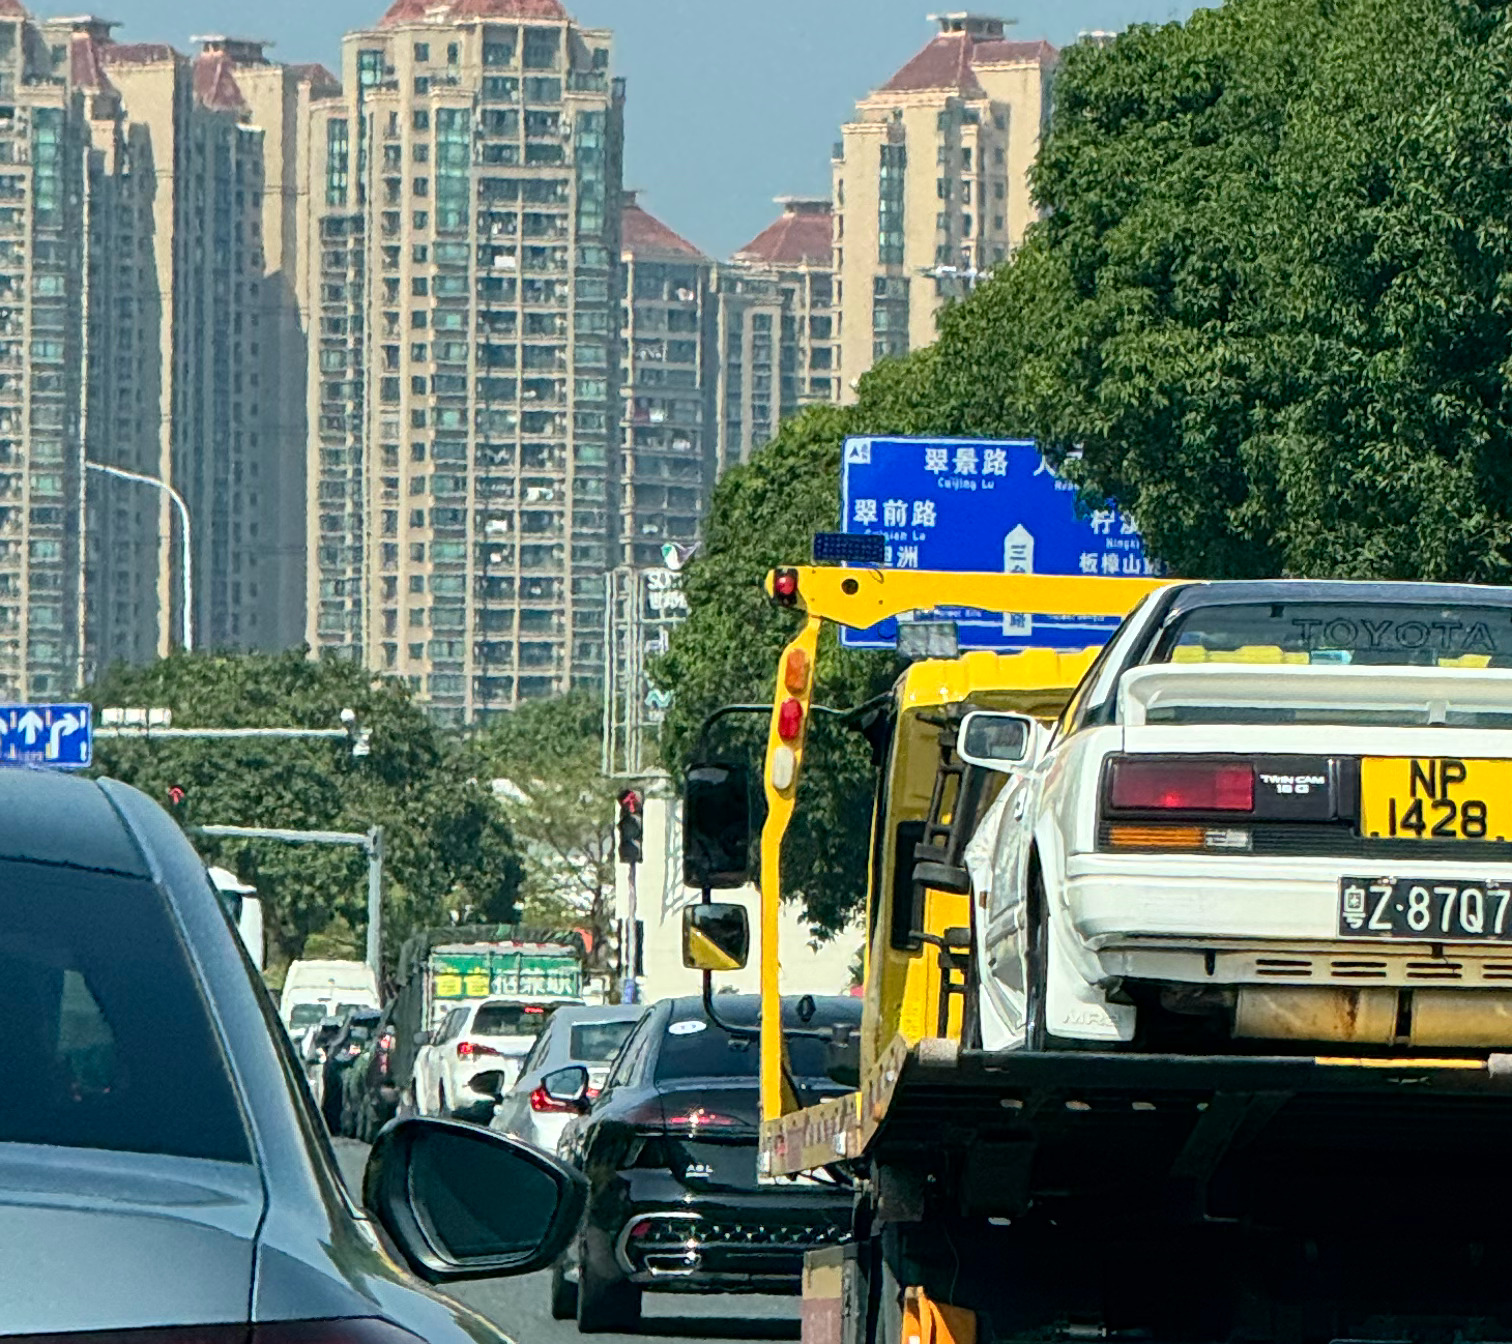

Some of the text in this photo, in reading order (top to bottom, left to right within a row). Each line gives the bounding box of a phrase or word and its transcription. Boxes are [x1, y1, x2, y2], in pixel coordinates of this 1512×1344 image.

[924, 447, 1008, 477] 翠景路
[938, 477, 995, 491] Cuijing Lu
[853, 499, 937, 528] 翠前路
[1292, 617, 1497, 651] TOYOTA
[1260, 774, 1325, 784] TWIN CAM
[1410, 759, 1467, 799] NP
[1389, 797, 1488, 838] 1428
